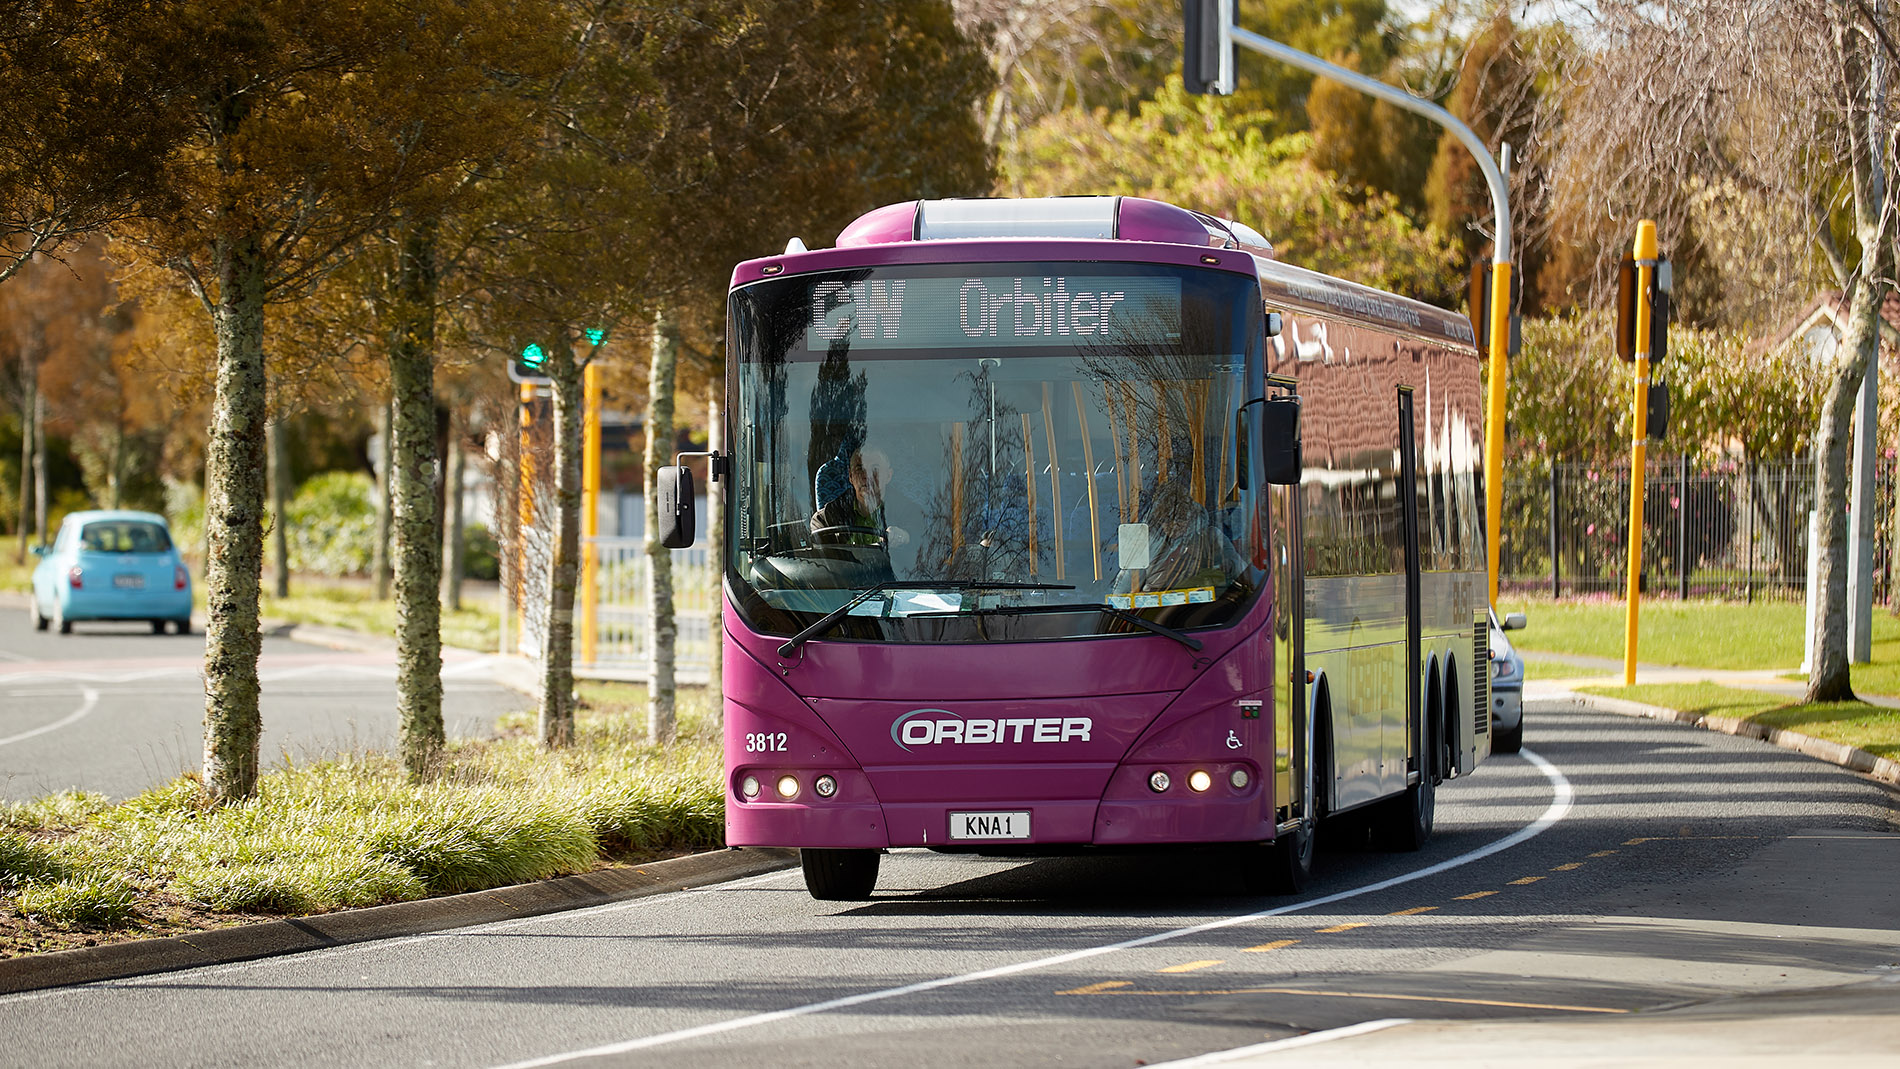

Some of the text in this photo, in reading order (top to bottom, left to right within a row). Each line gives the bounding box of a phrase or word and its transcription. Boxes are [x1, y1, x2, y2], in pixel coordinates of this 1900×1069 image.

[812, 277, 1126, 340] CW Orbiter
[745, 732, 788, 753] 3812
[901, 716, 1093, 746] ORBITER
[965, 816, 1012, 836] KNA1
